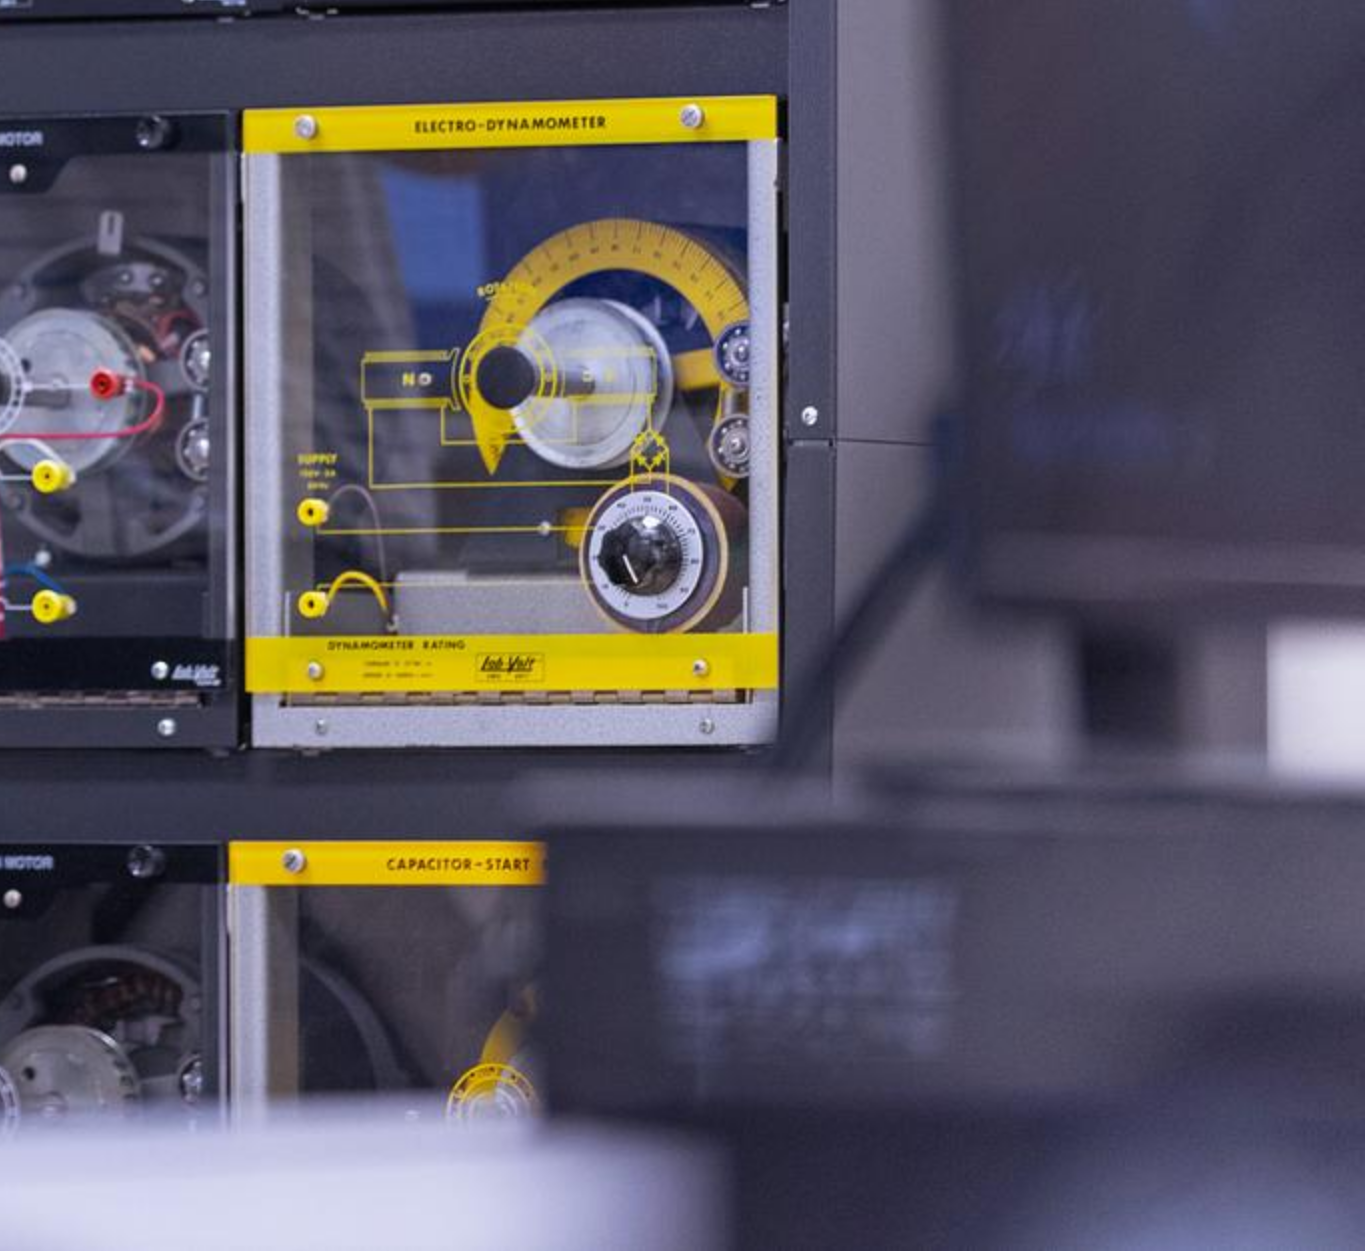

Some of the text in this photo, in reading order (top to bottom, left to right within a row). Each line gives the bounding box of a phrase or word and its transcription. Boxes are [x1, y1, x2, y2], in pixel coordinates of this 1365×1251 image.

[415, 116, 605, 133] ELECTRO-DYNAMOMETER
[297, 452, 338, 466] SUPPLY
[328, 640, 465, 650] DYNAMOMETER RATING
[4, 853, 54, 870] MOTOR
[387, 855, 532, 873] CAPACITOR-START
